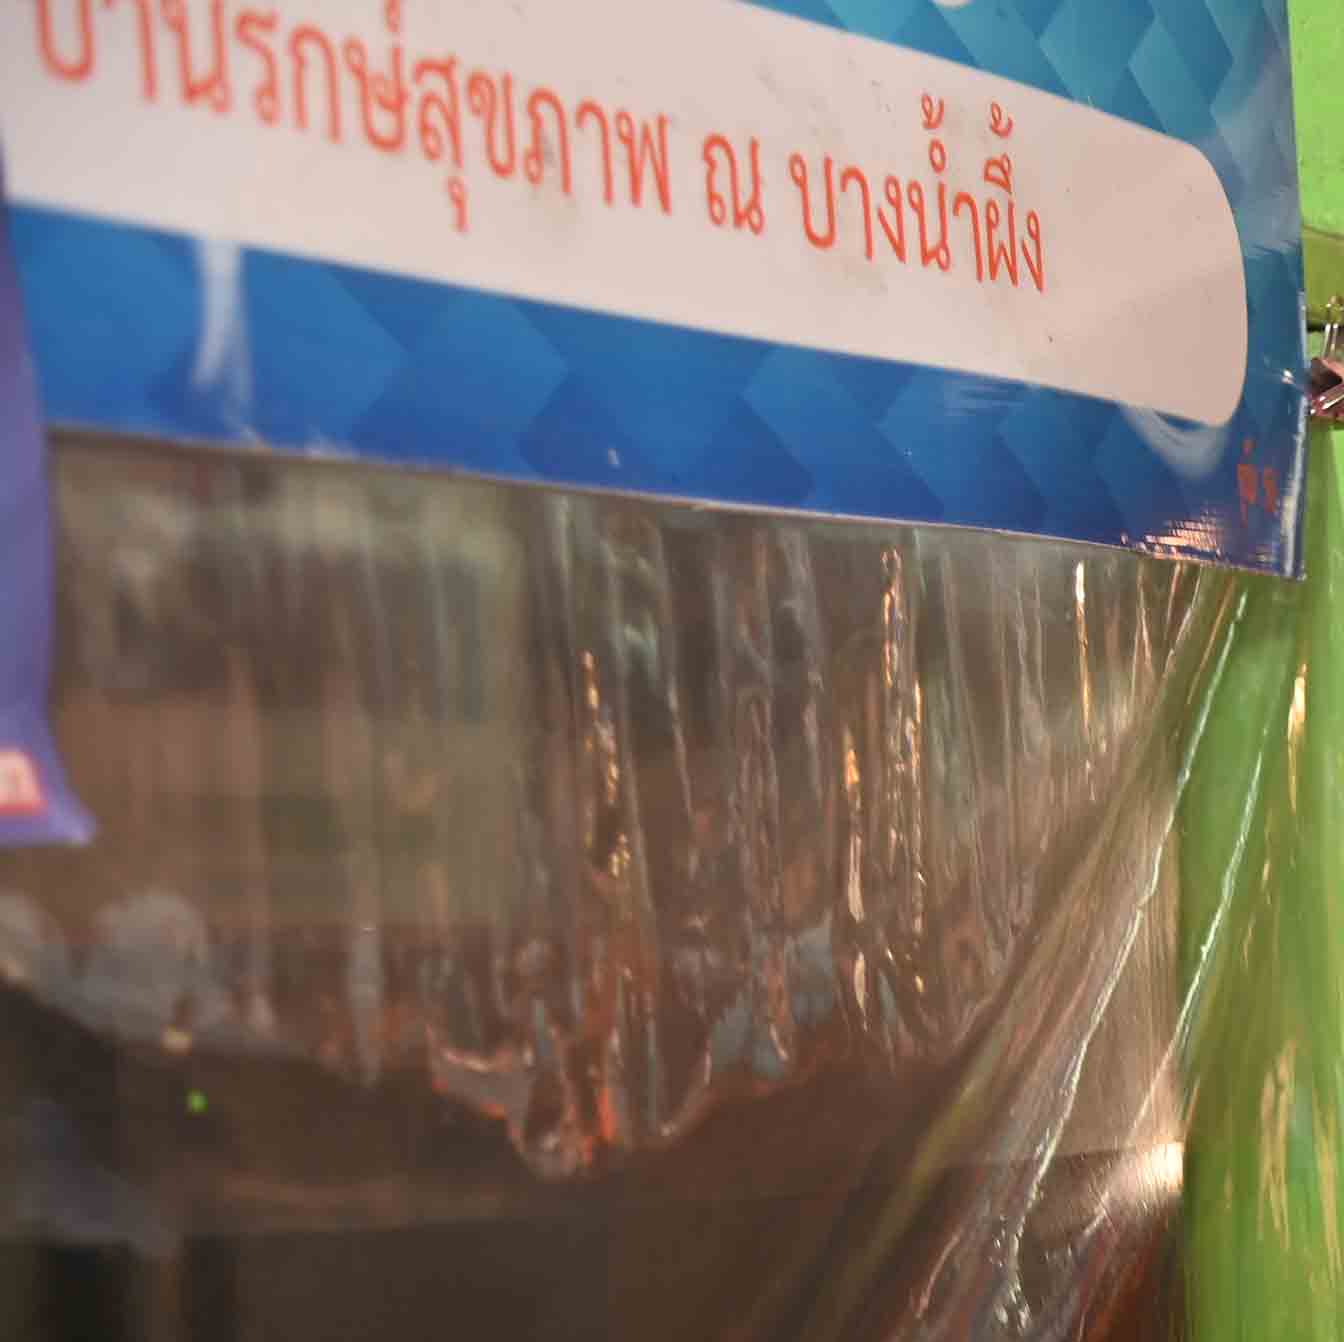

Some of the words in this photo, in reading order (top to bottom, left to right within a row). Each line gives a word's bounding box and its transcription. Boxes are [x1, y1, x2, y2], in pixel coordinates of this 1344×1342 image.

[32, 0, 672, 233] บานรกษ์สุขภาพ
[702, 131, 766, 236] ณ
[787, 91, 1046, 294] บางน้ำผึ้ง
